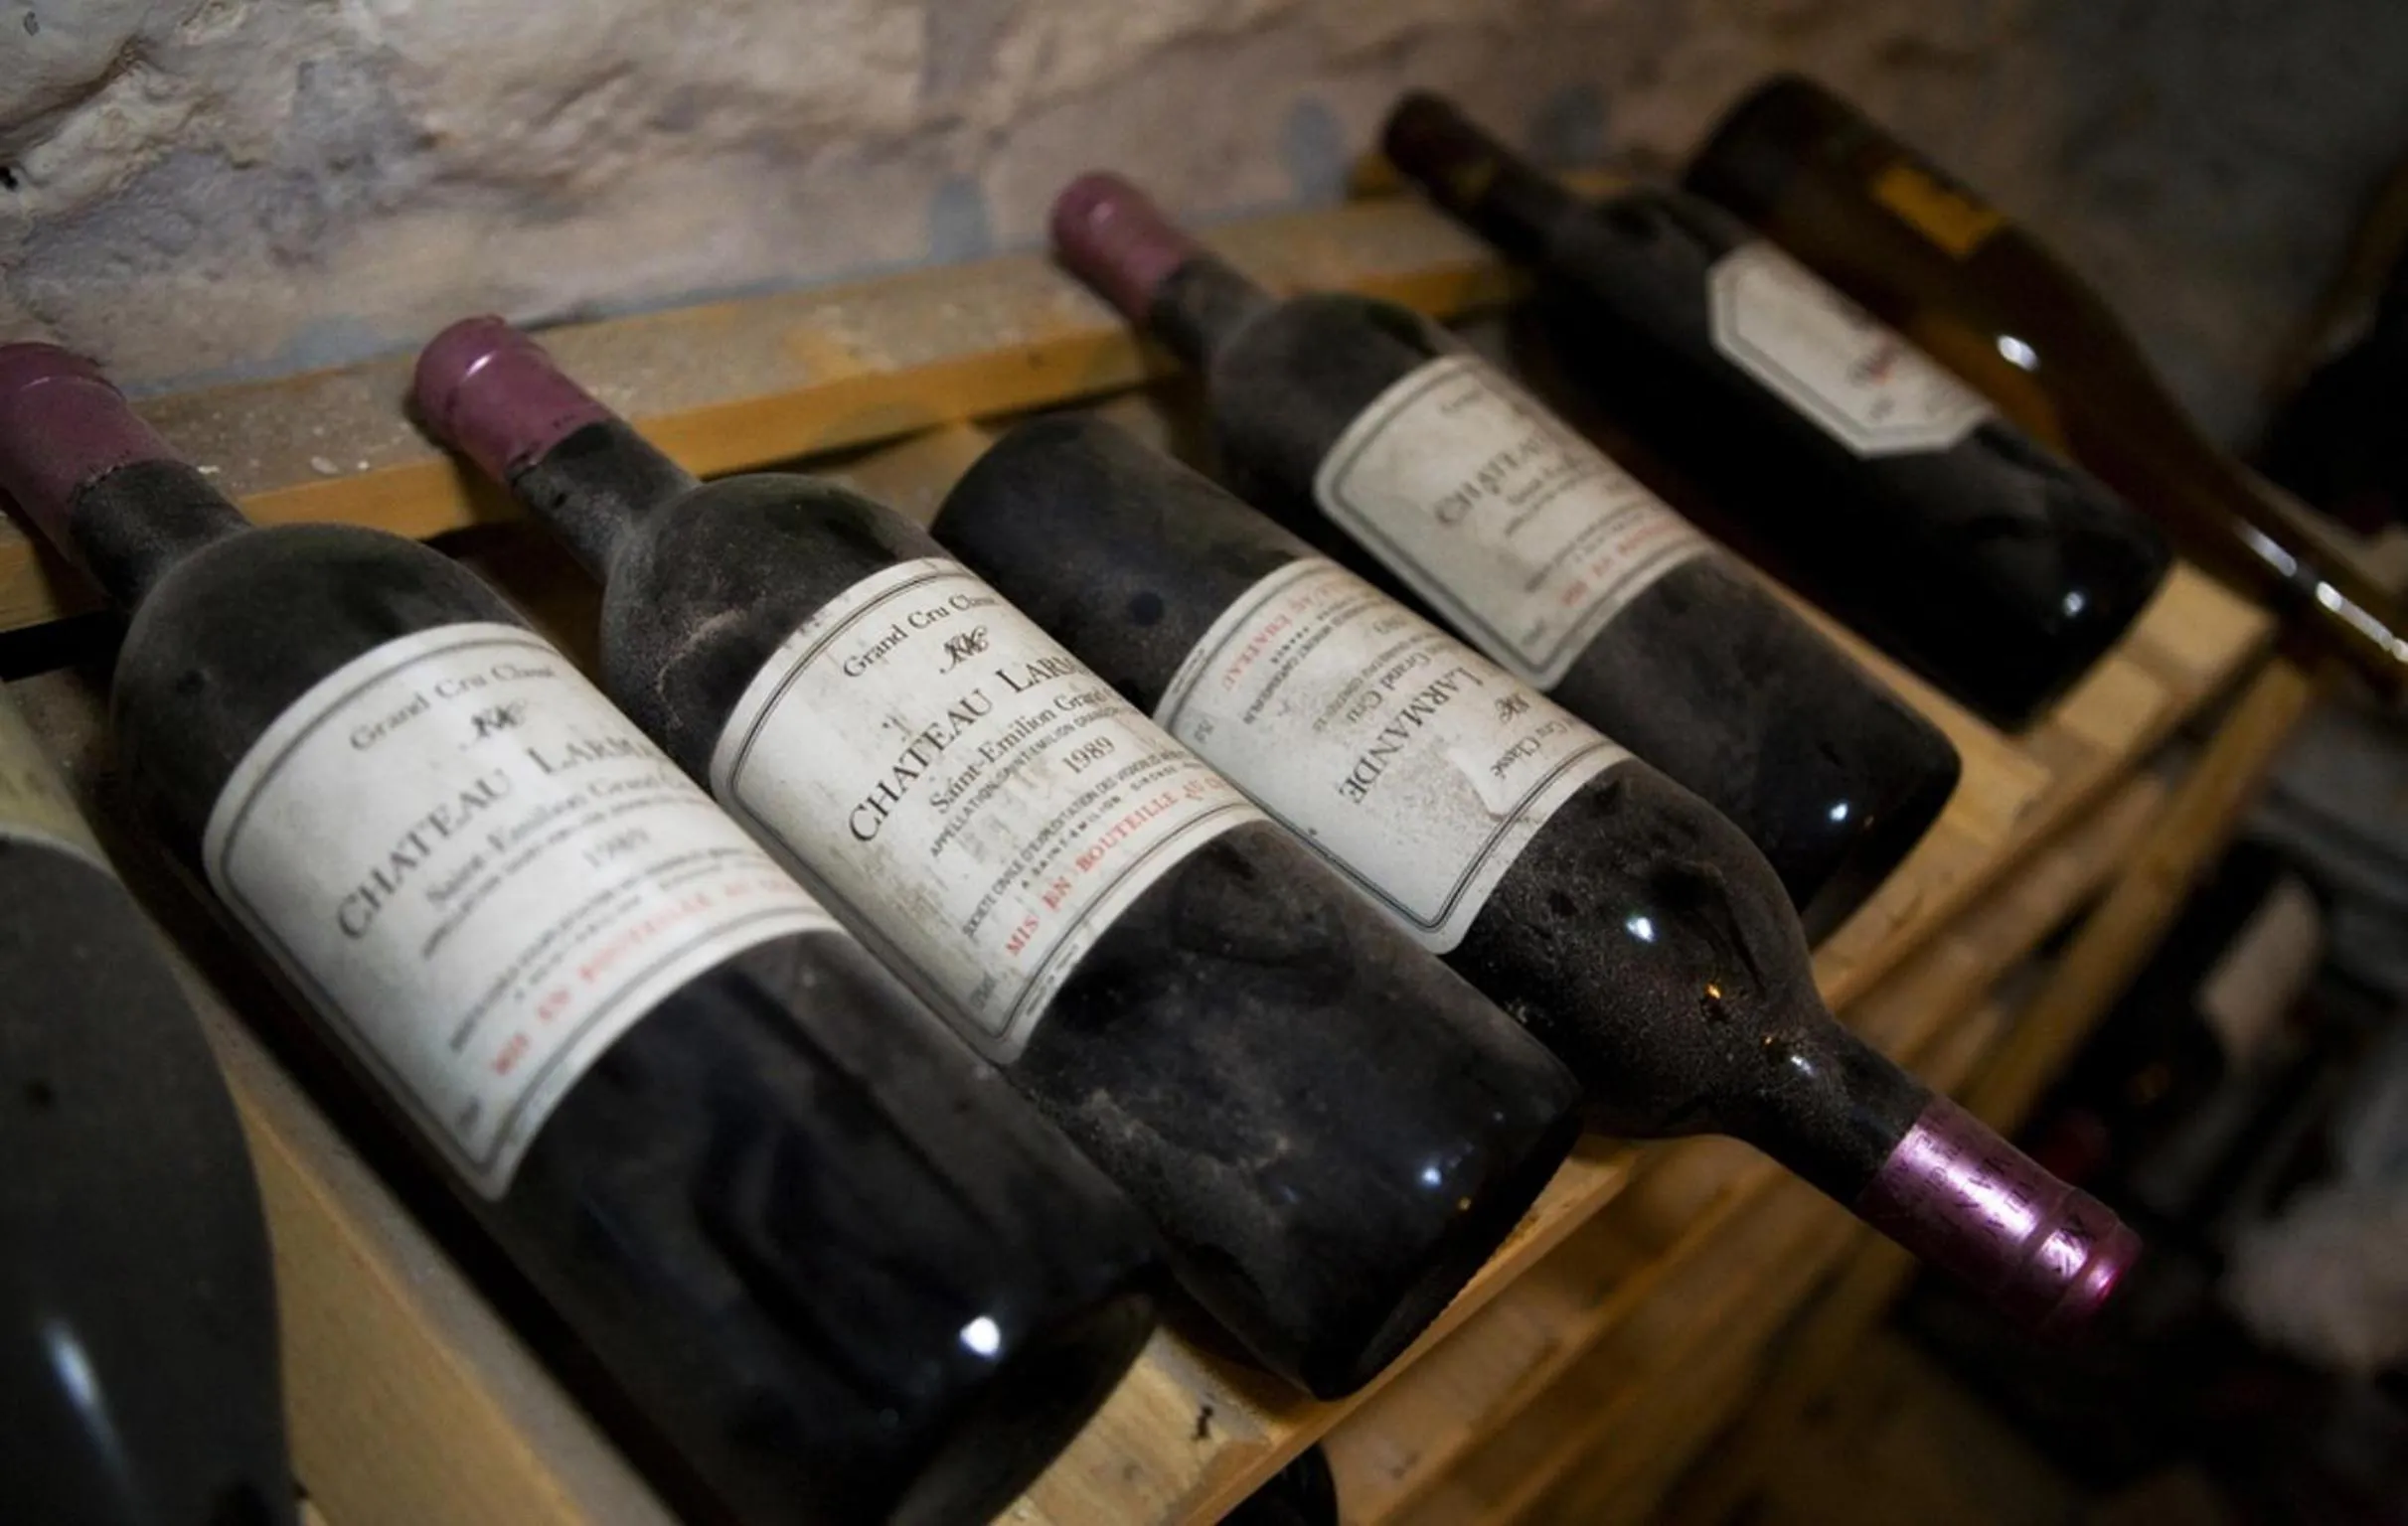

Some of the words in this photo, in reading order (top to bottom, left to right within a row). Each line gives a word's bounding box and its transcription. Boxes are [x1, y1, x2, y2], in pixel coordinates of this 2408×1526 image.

[843, 624, 909, 678] Grand
[906, 606, 950, 630] Cru
[1380, 651, 1431, 690] Grand
[350, 692, 431, 751] Grand
[433, 676, 489, 702] Cru
[1340, 667, 1484, 804] LARMANDE
[1347, 689, 1383, 725] Cru
[848, 687, 994, 842] CHATEAU
[928, 707, 1057, 815] Saint-Emilion
[1061, 735, 1115, 775] 1989
[336, 767, 514, 940] CHATEAU
[1006, 913, 1040, 956] MIS
[1043, 875, 1072, 913] EN
[1075, 791, 1180, 873] BOUTEILLE
